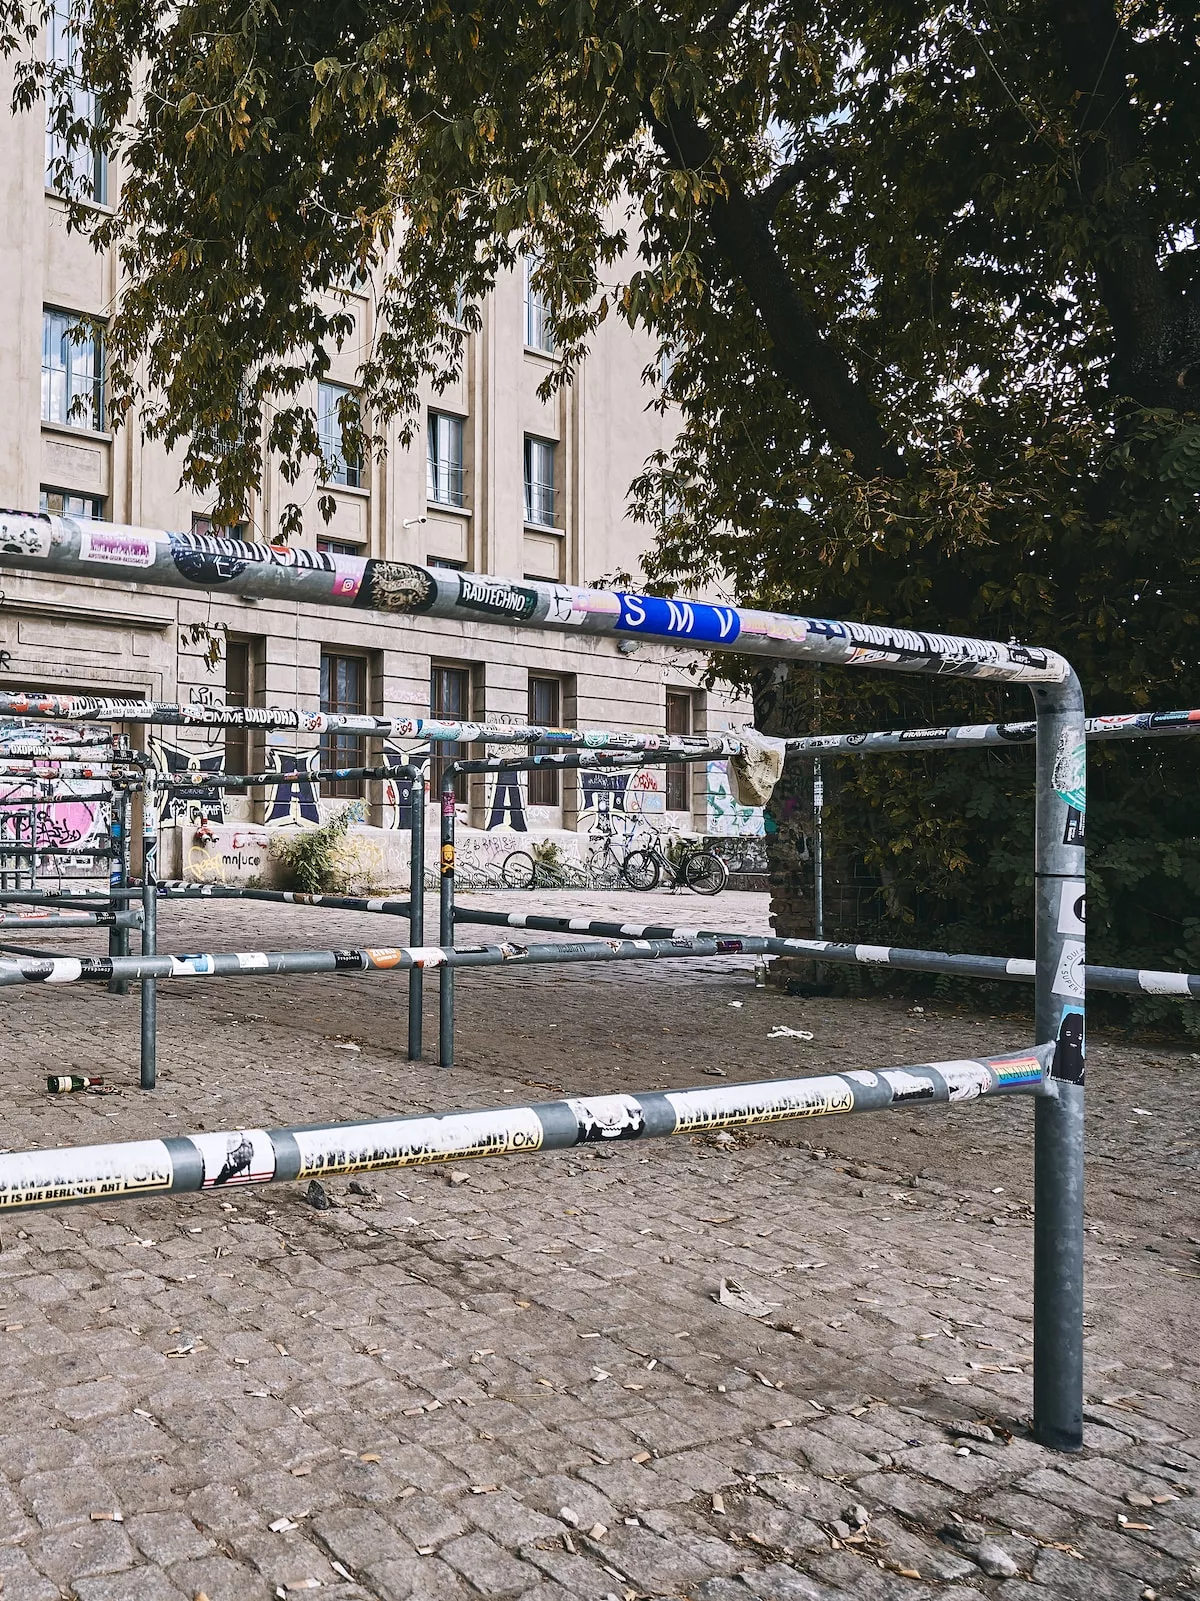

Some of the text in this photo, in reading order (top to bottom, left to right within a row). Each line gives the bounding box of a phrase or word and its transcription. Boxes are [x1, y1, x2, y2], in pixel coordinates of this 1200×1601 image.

[244, 709, 297, 726] ОХОРОНА
[11, 1192, 22, 1203] IS
[25, 1190, 44, 1202] DIE
[45, 1185, 96, 1199] BERLINER
[100, 1182, 121, 1193] ART
